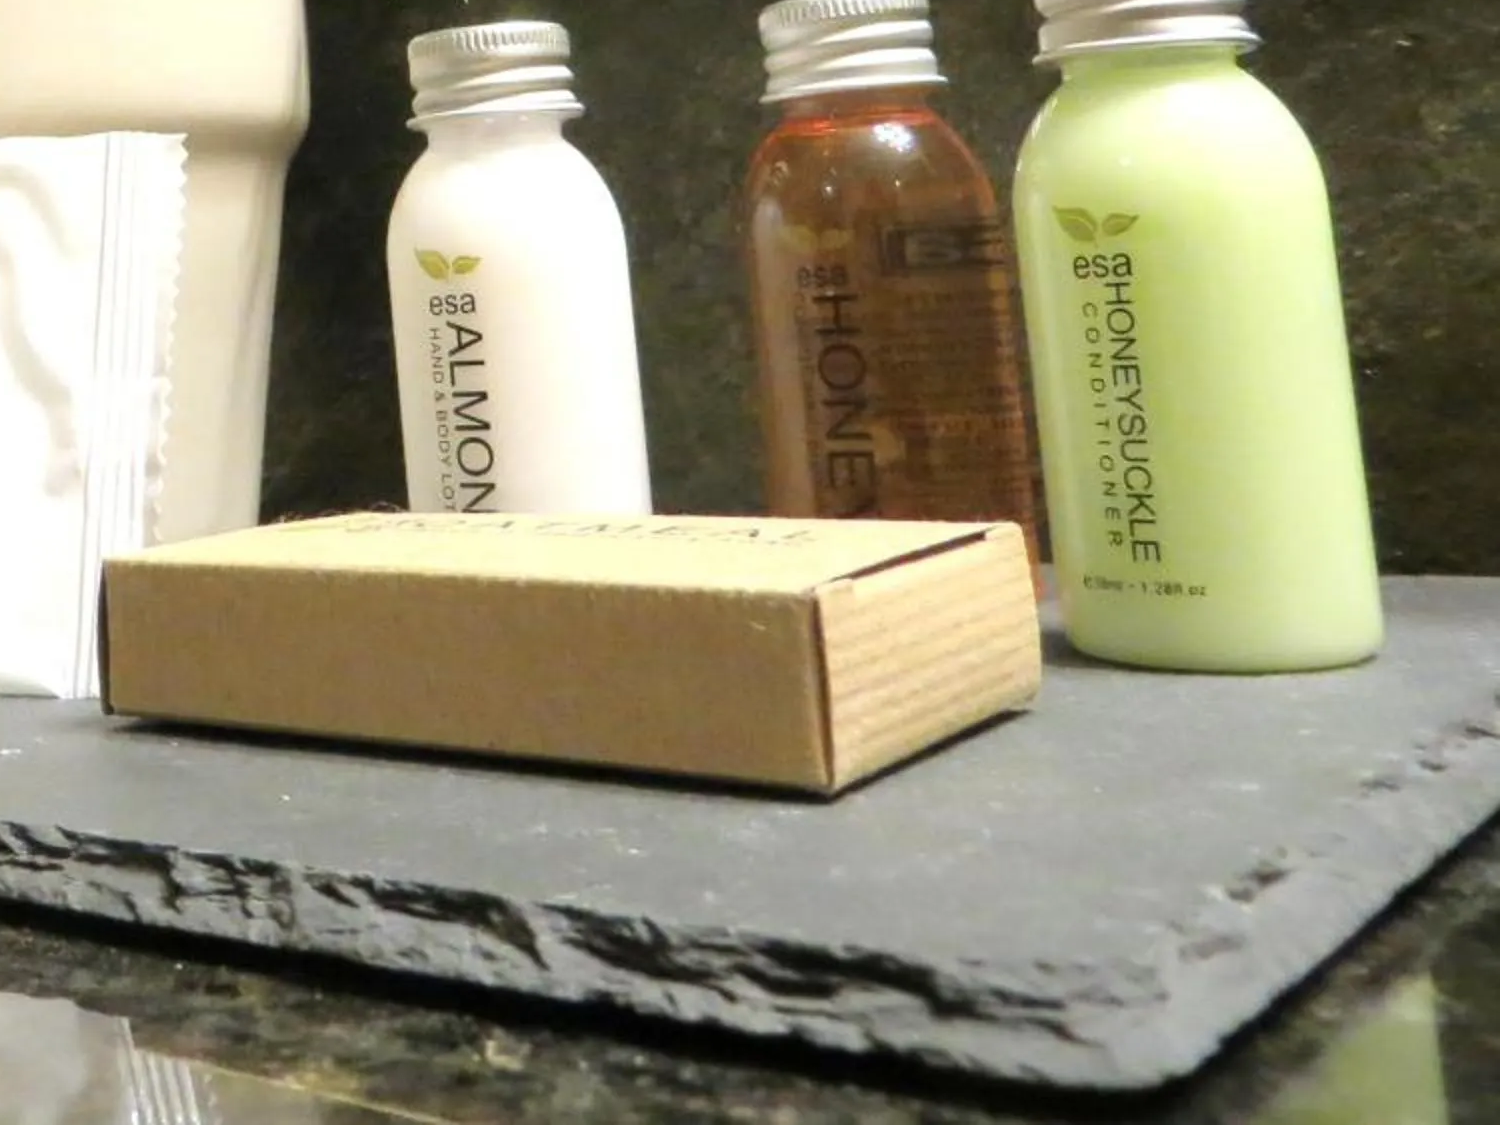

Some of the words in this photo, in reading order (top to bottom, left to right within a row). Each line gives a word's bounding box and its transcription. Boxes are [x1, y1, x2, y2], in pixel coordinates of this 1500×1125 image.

[1073, 251, 1133, 279] esa
[429, 292, 477, 316] esa
[428, 326, 445, 385] HAND
[436, 410, 452, 466] BODY
[445, 320, 498, 513] ALMON
[1082, 301, 1124, 547] CONDITIONER
[1105, 281, 1161, 565] HONEYSUCKLE
